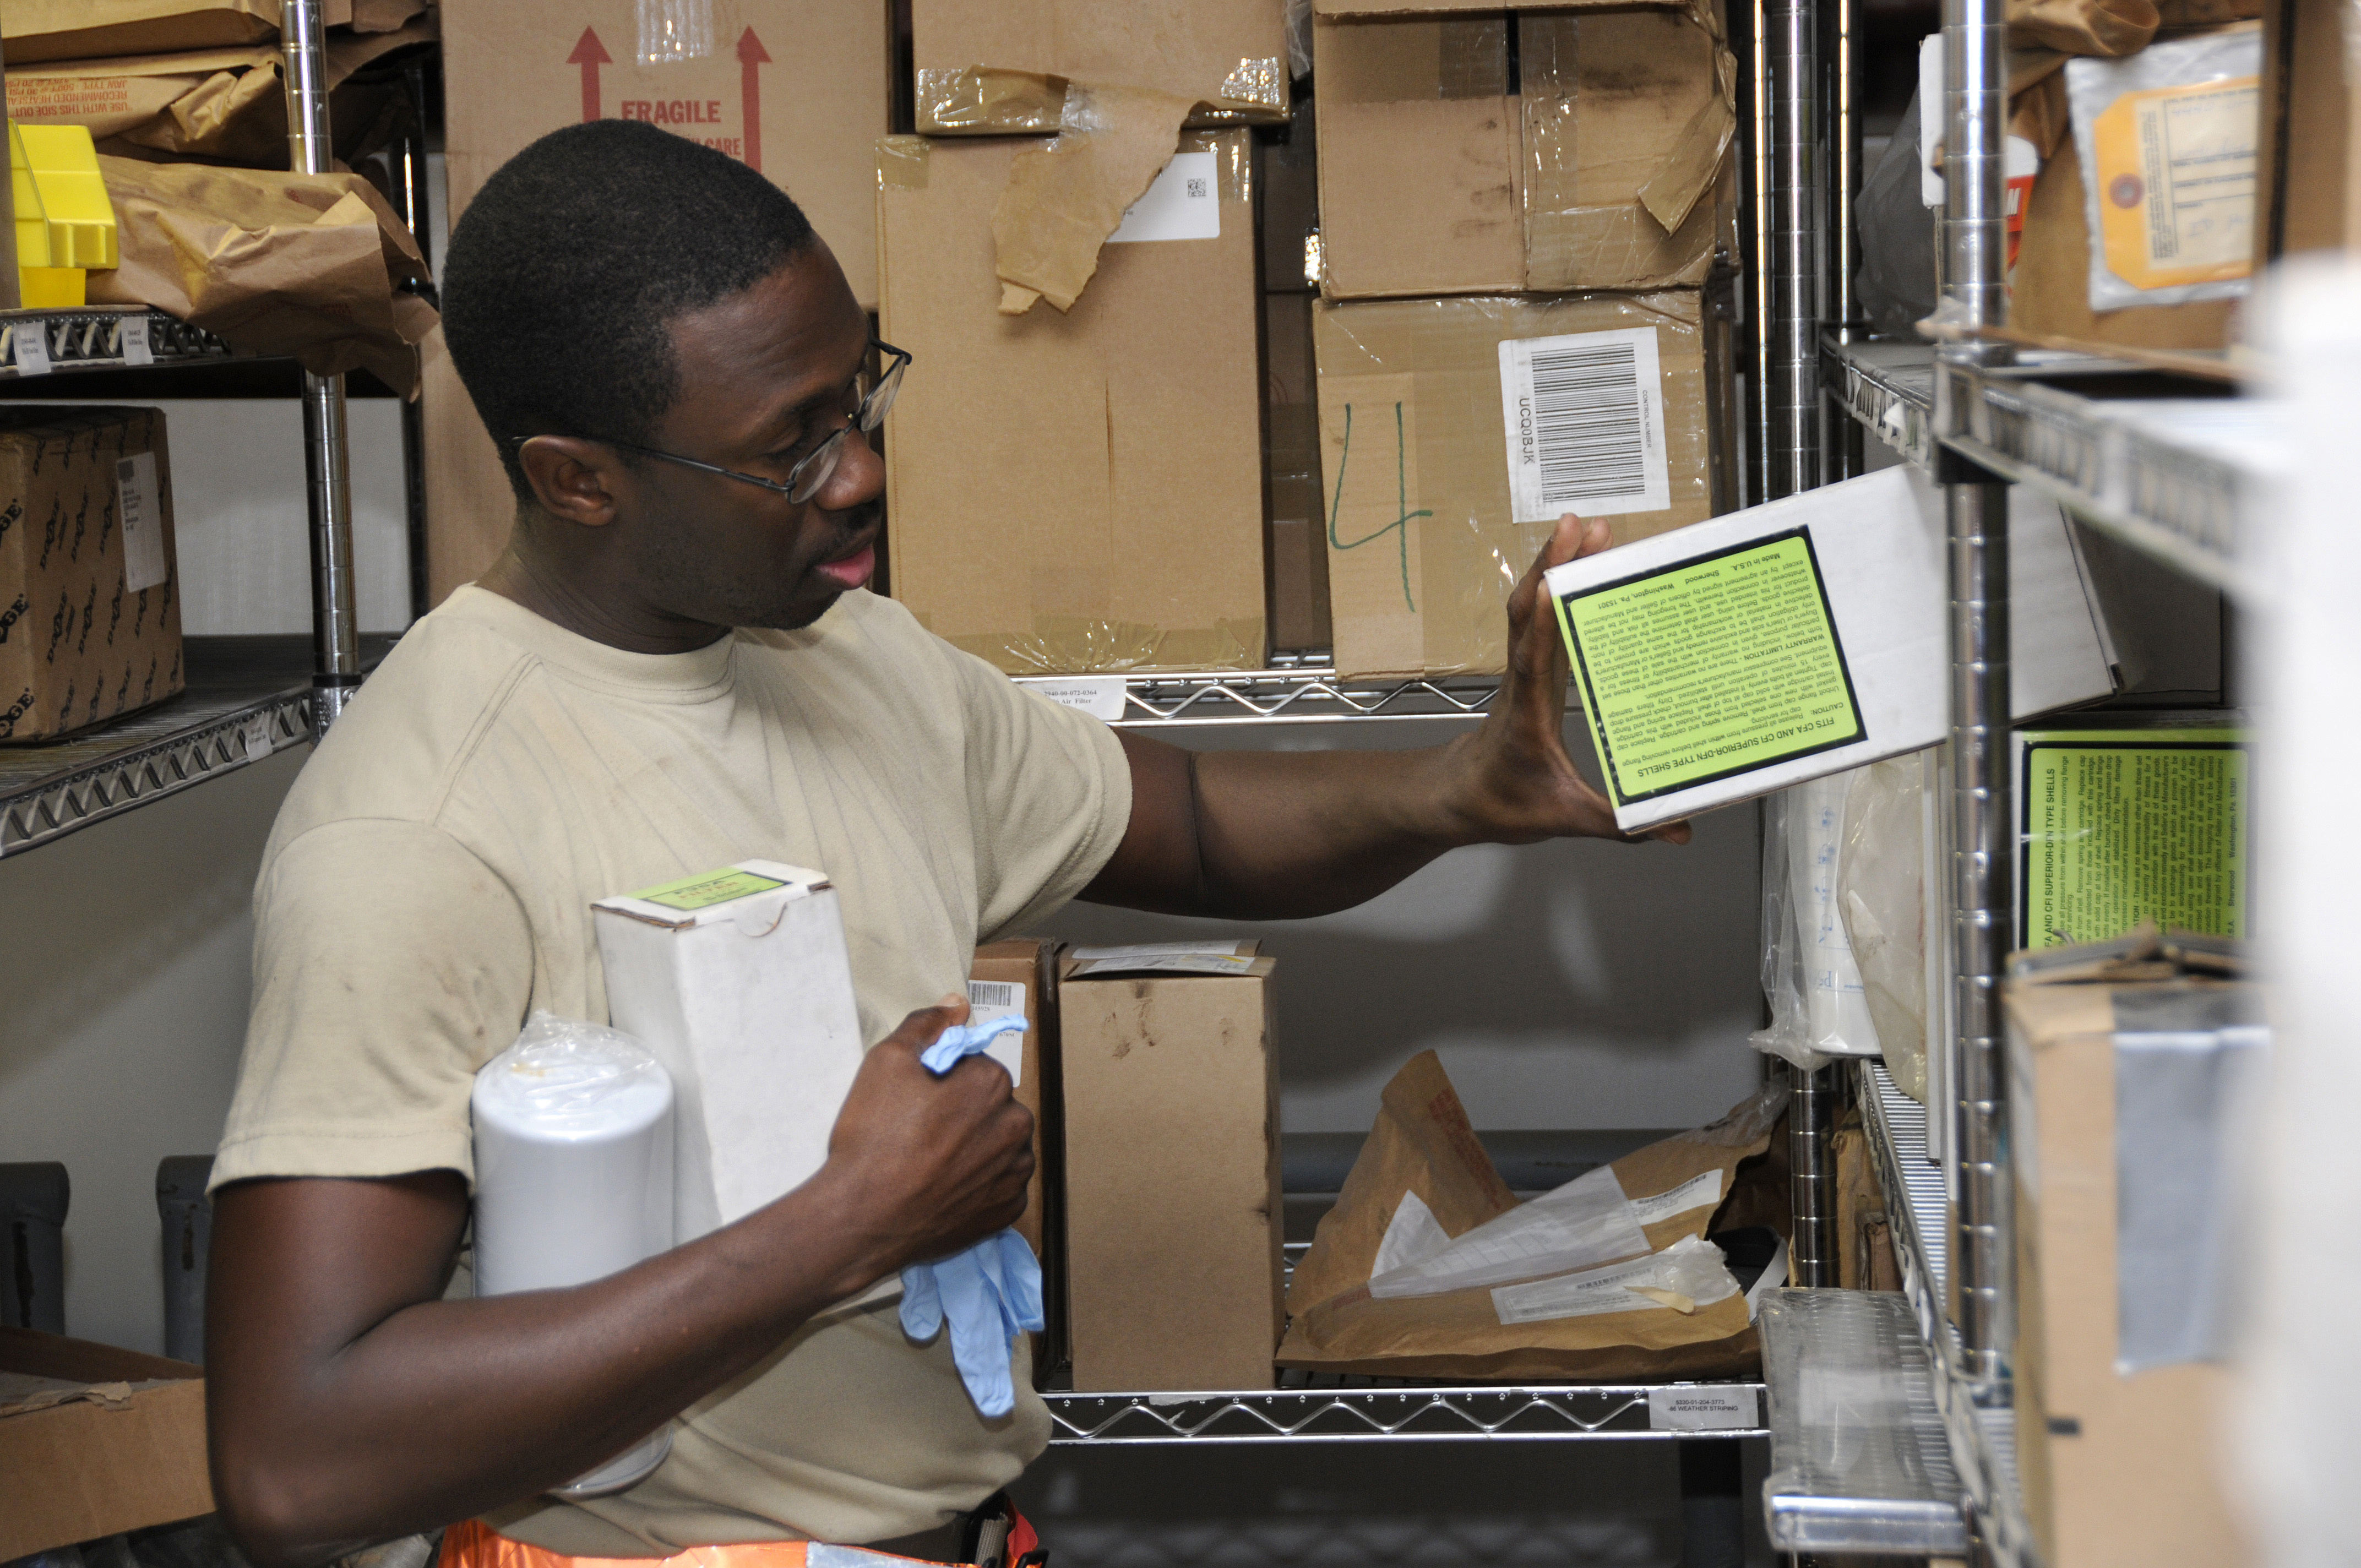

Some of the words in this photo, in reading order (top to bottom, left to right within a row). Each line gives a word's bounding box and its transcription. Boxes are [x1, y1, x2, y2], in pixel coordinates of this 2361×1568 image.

[107, 79, 127, 89] JAW
[54, 91, 127, 102] RECOMMENDED
[37, 105, 57, 116] SIDE
[59, 104, 80, 114] THIS
[83, 103, 107, 113] WITH
[621, 100, 721, 124] FRAGILE
[1760, 552, 1781, 563] Made
[1782, 559, 1804, 570] except
[1684, 569, 1720, 586] Sherwood
[1723, 571, 1758, 587] agreement
[1701, 581, 1723, 594] signed
[1659, 598, 1667, 606] of
[1667, 591, 1691, 602] officers
[1597, 598, 1618, 610] 15301
[1639, 600, 1658, 611] Seller
[1625, 606, 1638, 616] and
[1784, 633, 1825, 650] WARRANTY
[1743, 644, 1784, 661] LIMITATION
[1779, 654, 1793, 662] See
[1718, 657, 1739, 667] There
[1743, 657, 1779, 672] compressor
[1664, 668, 1697, 682] warranties
[1696, 668, 1742, 685] manufacturer's
[1631, 682, 1647, 692] than
[1646, 677, 1664, 687] other
[1815, 675, 1837, 688] gasket
[1612, 687, 1631, 696] those
[1784, 687, 1798, 696] new
[1799, 683, 1814, 692] with
[1818, 684, 1840, 696] Unbolt
[1601, 692, 1612, 701] set
[1769, 692, 1782, 700] one
[1783, 696, 1796, 705] cap
[1797, 691, 1818, 701] flange
[1740, 695, 1767, 709] selected
[1767, 700, 1783, 709] from
[1704, 708, 1722, 718] those
[1723, 704, 1739, 712] from
[1788, 705, 1802, 714] cap
[1674, 714, 1702, 727] included
[1721, 710, 1749, 722] Remove
[1777, 712, 1804, 724] Release
[1659, 722, 1673, 731] with
[1687, 723, 1700, 732] and
[1700, 717, 1722, 727] spring
[1741, 720, 1769, 734] pressure
[1769, 719, 1777, 727] all
[1814, 716, 1835, 729] FITS
[1645, 726, 1658, 734] this
[1726, 729, 1742, 738] from
[1775, 726, 1794, 739] AND
[1794, 722, 1815, 734] CFA
[1629, 735, 1657, 748] Replace
[1691, 738, 1707, 749] shell
[1707, 733, 1726, 743] within
[1759, 732, 1775, 744] CFI
[1616, 743, 1629, 751] cap
[1671, 742, 1693, 753] before
[1695, 736, 1760, 762] SUPERIOR-DFN
[1640, 749, 1671, 761] removing
[1621, 756, 1642, 767] flange
[1671, 754, 1696, 769] TYPE
[1636, 761, 1672, 778] SHELLS
[2047, 769, 2055, 803] SHELLS
[2046, 806, 2054, 827] TYPE
[2046, 831, 2054, 895] SUPERIOR-DFN
